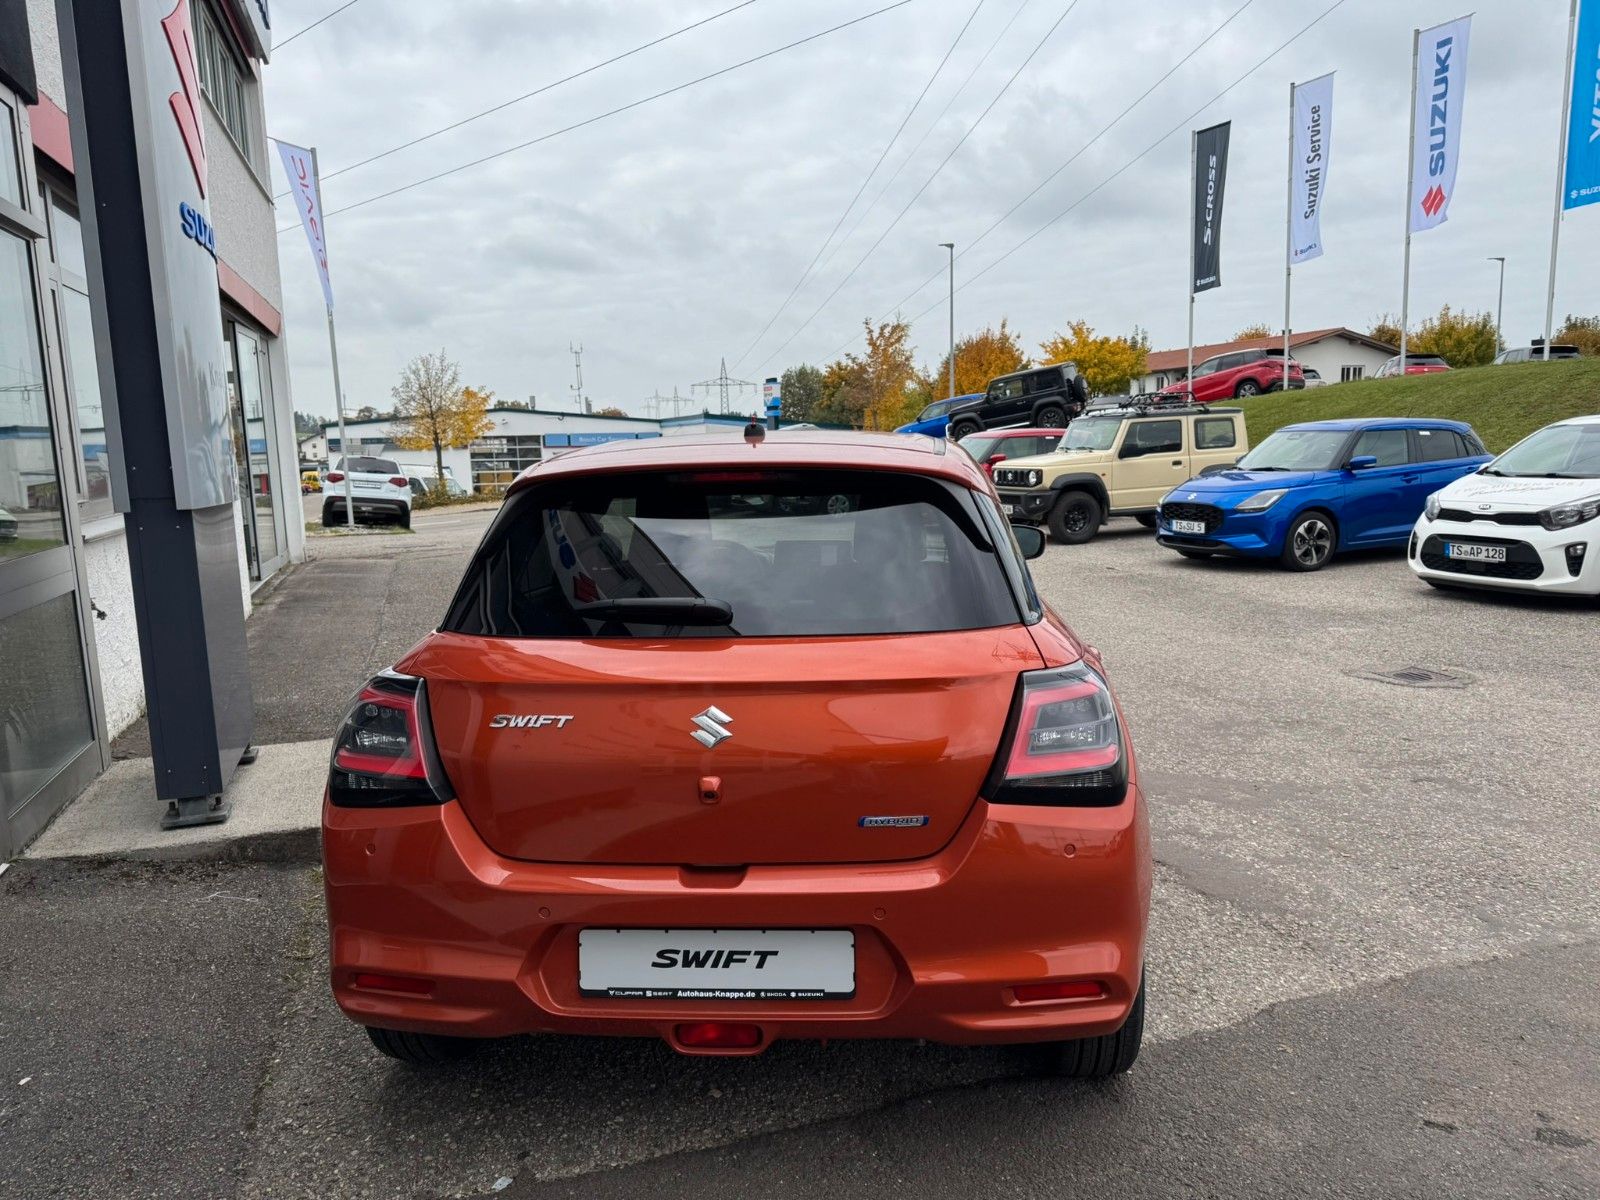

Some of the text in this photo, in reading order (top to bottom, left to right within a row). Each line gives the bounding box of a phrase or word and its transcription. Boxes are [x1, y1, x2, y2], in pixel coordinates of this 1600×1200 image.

[1429, 37, 1453, 177] SUZUKI
[1304, 105, 1321, 220] Suzuki Service
[1203, 154, 1217, 246] S-CROSS
[1450, 544, 1504, 559] TS AP 128
[489, 714, 575, 728] SWIFT
[868, 817, 920, 825] HYBRID
[651, 949, 779, 969] SWIFT
[677, 990, 756, 999] Autohaus-Knappe.de
